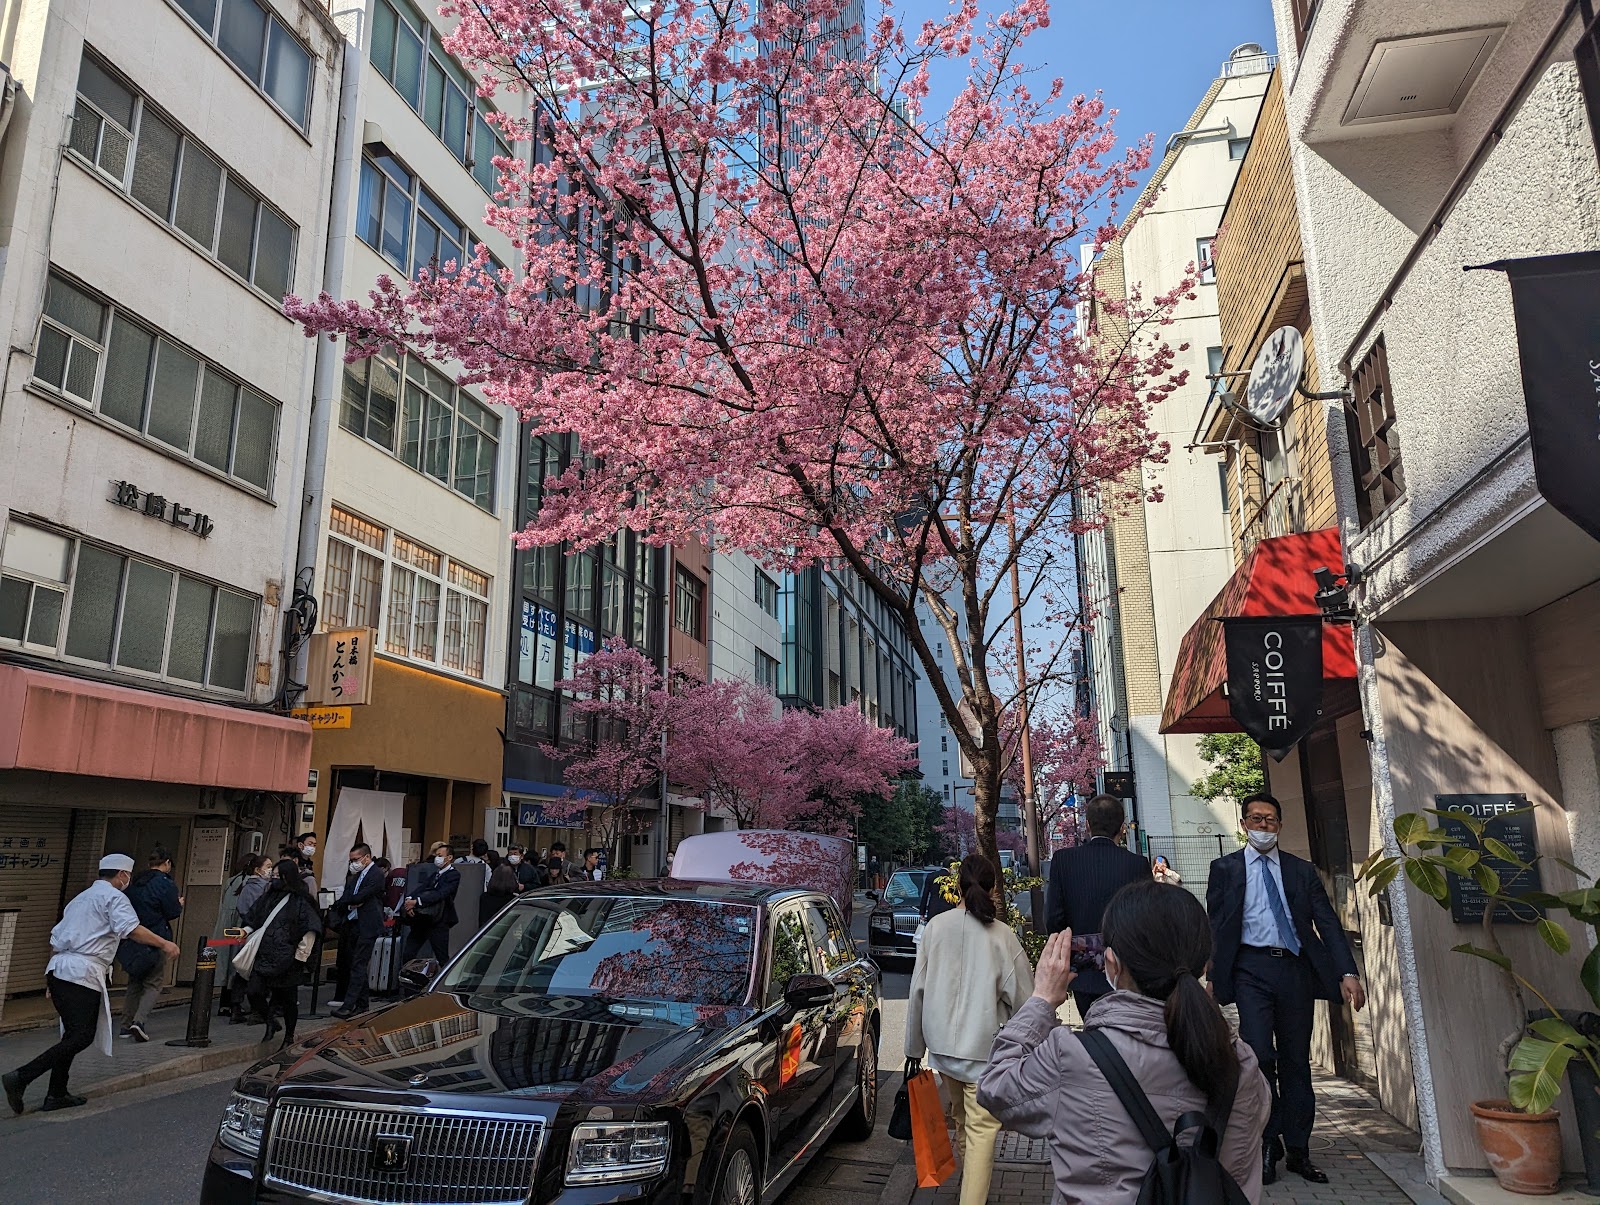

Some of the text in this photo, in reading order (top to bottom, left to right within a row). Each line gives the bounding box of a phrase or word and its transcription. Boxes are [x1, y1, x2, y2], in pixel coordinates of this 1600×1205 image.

[331, 640, 346, 698] とんかつ
[348, 636, 359, 666] 日本橋
[1264, 631, 1292, 731] COIFFÉ
